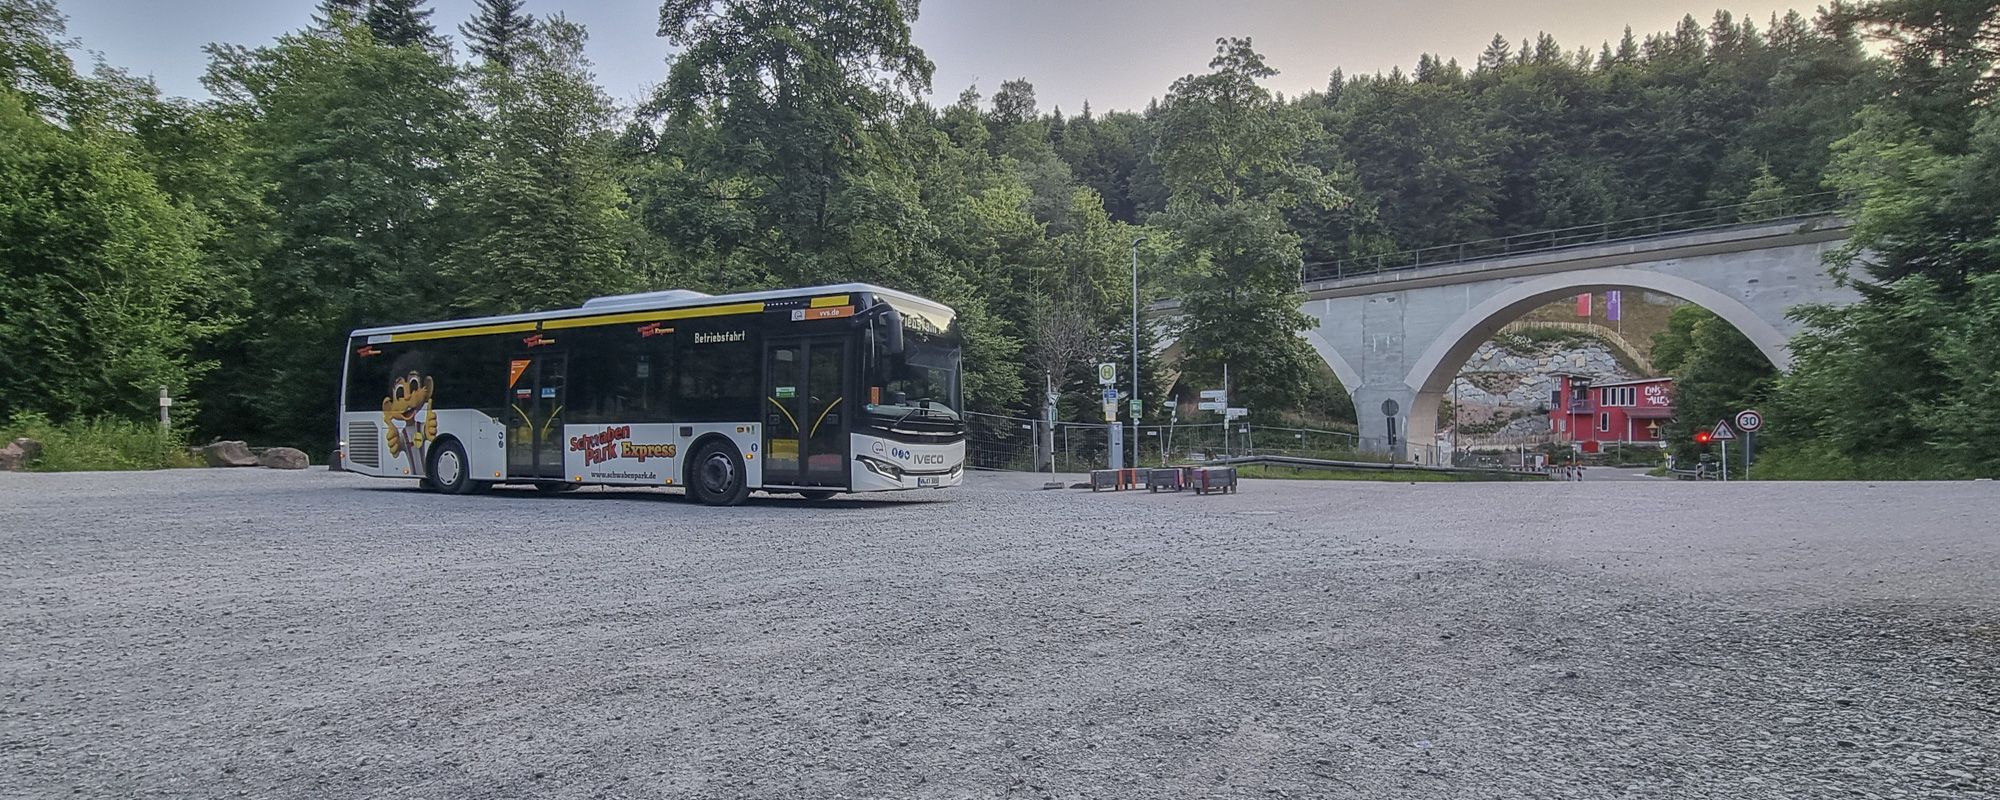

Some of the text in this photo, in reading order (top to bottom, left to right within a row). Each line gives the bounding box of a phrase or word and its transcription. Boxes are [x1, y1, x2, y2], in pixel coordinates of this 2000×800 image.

[820, 308, 840, 316] vvs.de
[694, 330, 746, 344] Betriebsfahrt
[1742, 416, 1756, 426] 30
[570, 425, 631, 451] Schwaben
[585, 441, 676, 467] Park Express
[913, 454, 944, 465] IVECO
[591, 471, 657, 480] www.schwabenpark.de
